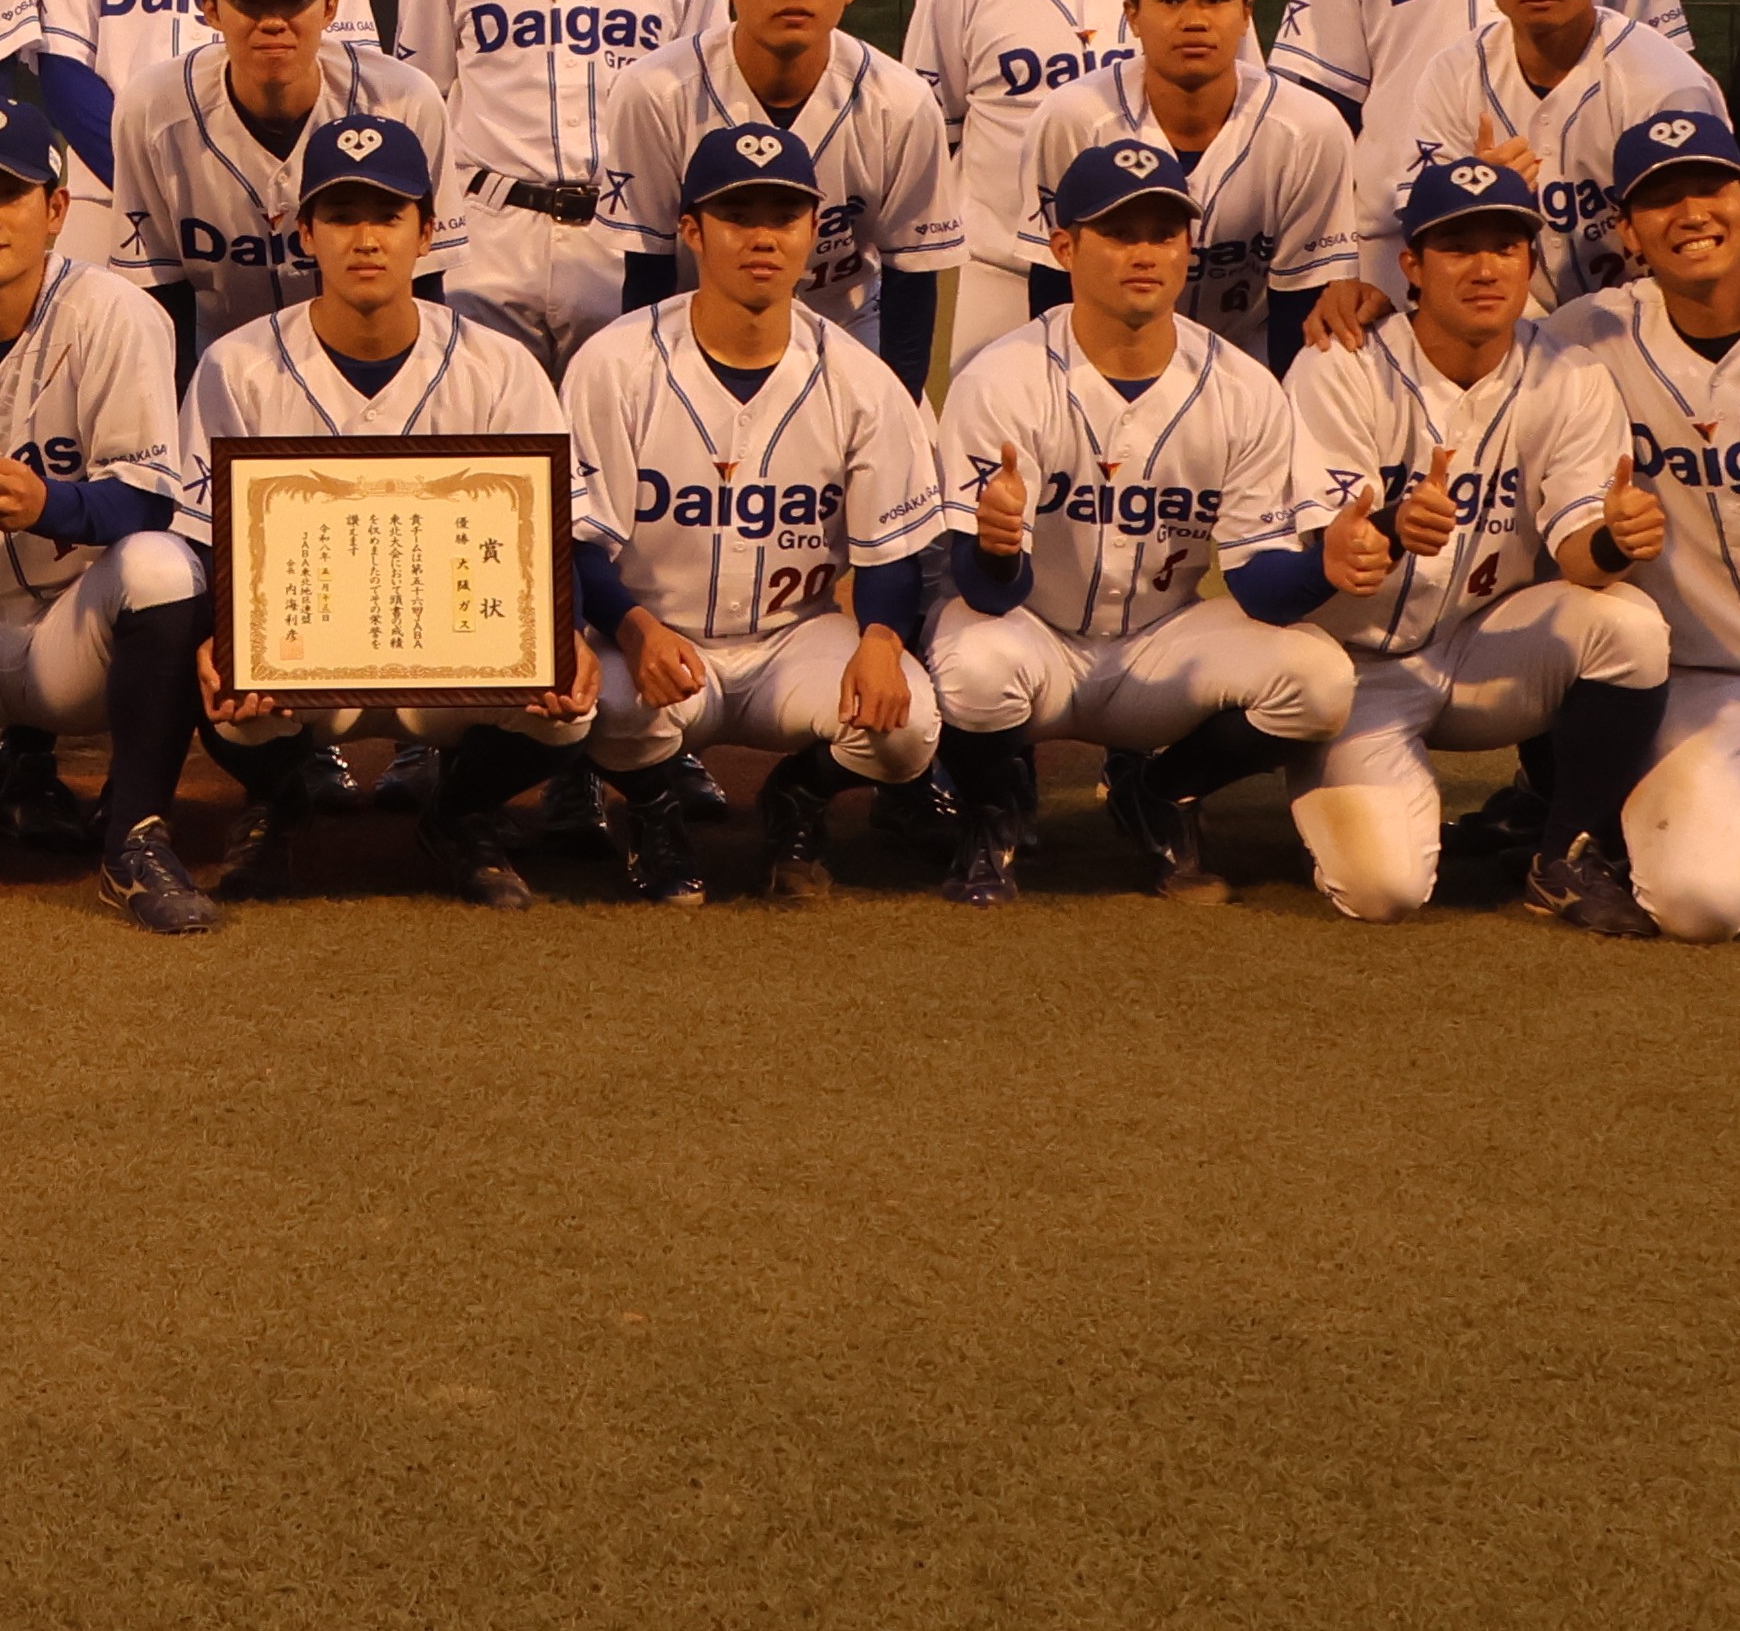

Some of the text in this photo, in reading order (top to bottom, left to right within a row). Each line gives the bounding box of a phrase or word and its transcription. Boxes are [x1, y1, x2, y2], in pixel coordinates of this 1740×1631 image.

[471, 2, 662, 55] Daigas
[635, 468, 843, 539] Daigas
[889, 496, 927, 521] OSAKA
[455, 516, 470, 544] 優勝
[479, 538, 506, 618] 賞状
[767, 563, 837, 615] 20
[1468, 552, 1499, 597] 4
